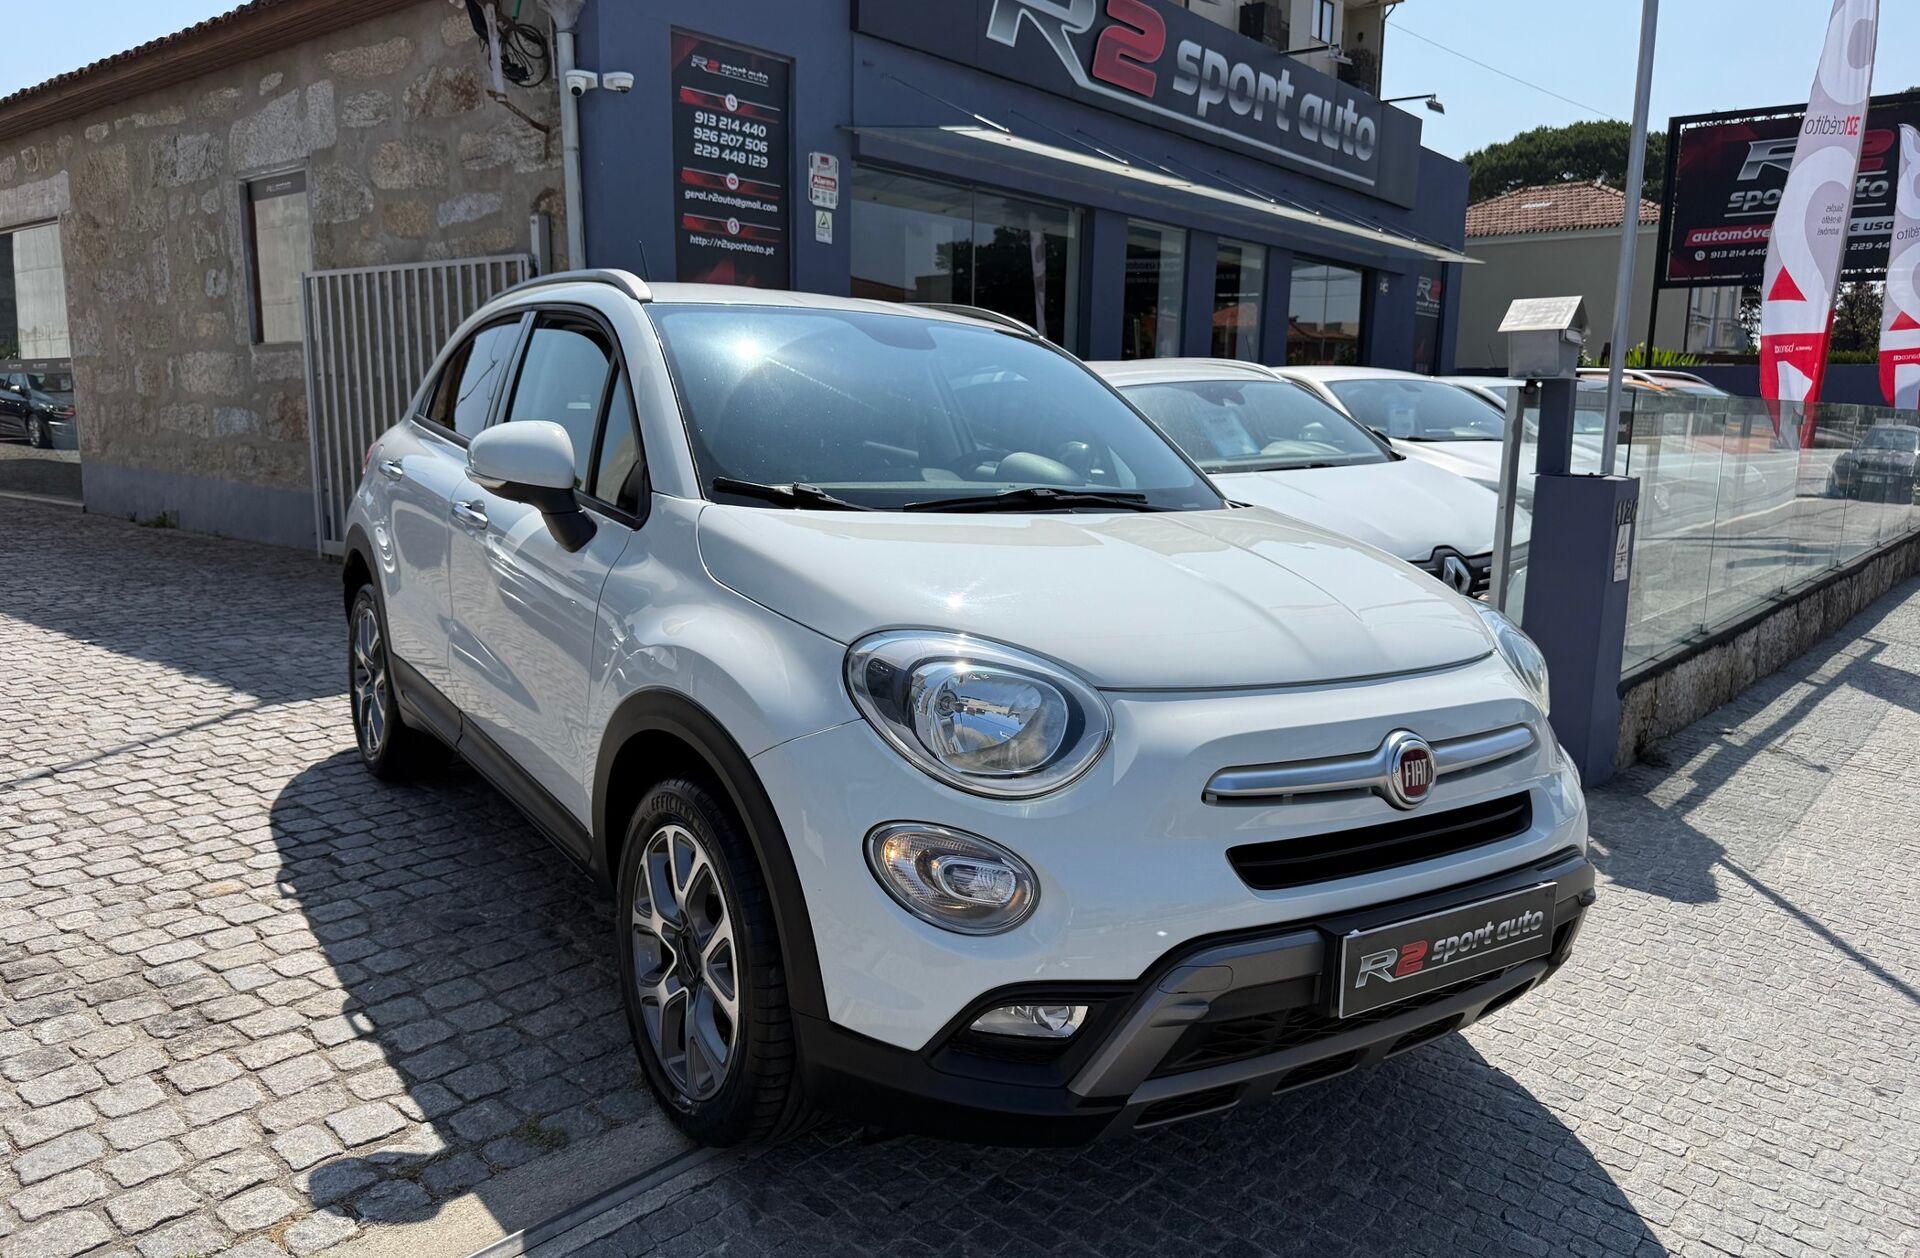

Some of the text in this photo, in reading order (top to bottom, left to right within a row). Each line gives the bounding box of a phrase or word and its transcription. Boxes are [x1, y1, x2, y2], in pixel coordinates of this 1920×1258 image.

[691, 55, 769, 83] R2 sport auto
[1173, 39, 1295, 131] sport
[1299, 92, 1376, 161] auto
[695, 111, 767, 138] 913 214 440
[693, 127, 769, 153] 926 207 506
[693, 142, 769, 168] 229 448 129
[1728, 187, 1782, 211] spo
[1692, 227, 1770, 243] automóve
[1863, 221, 1894, 231] usa
[689, 235, 774, 256] http://r2sportauto.pt
[1850, 241, 1890, 251] 229 44
[1404, 759, 1427, 788] FIAT
[1355, 910, 1544, 989] R2 sport auto
